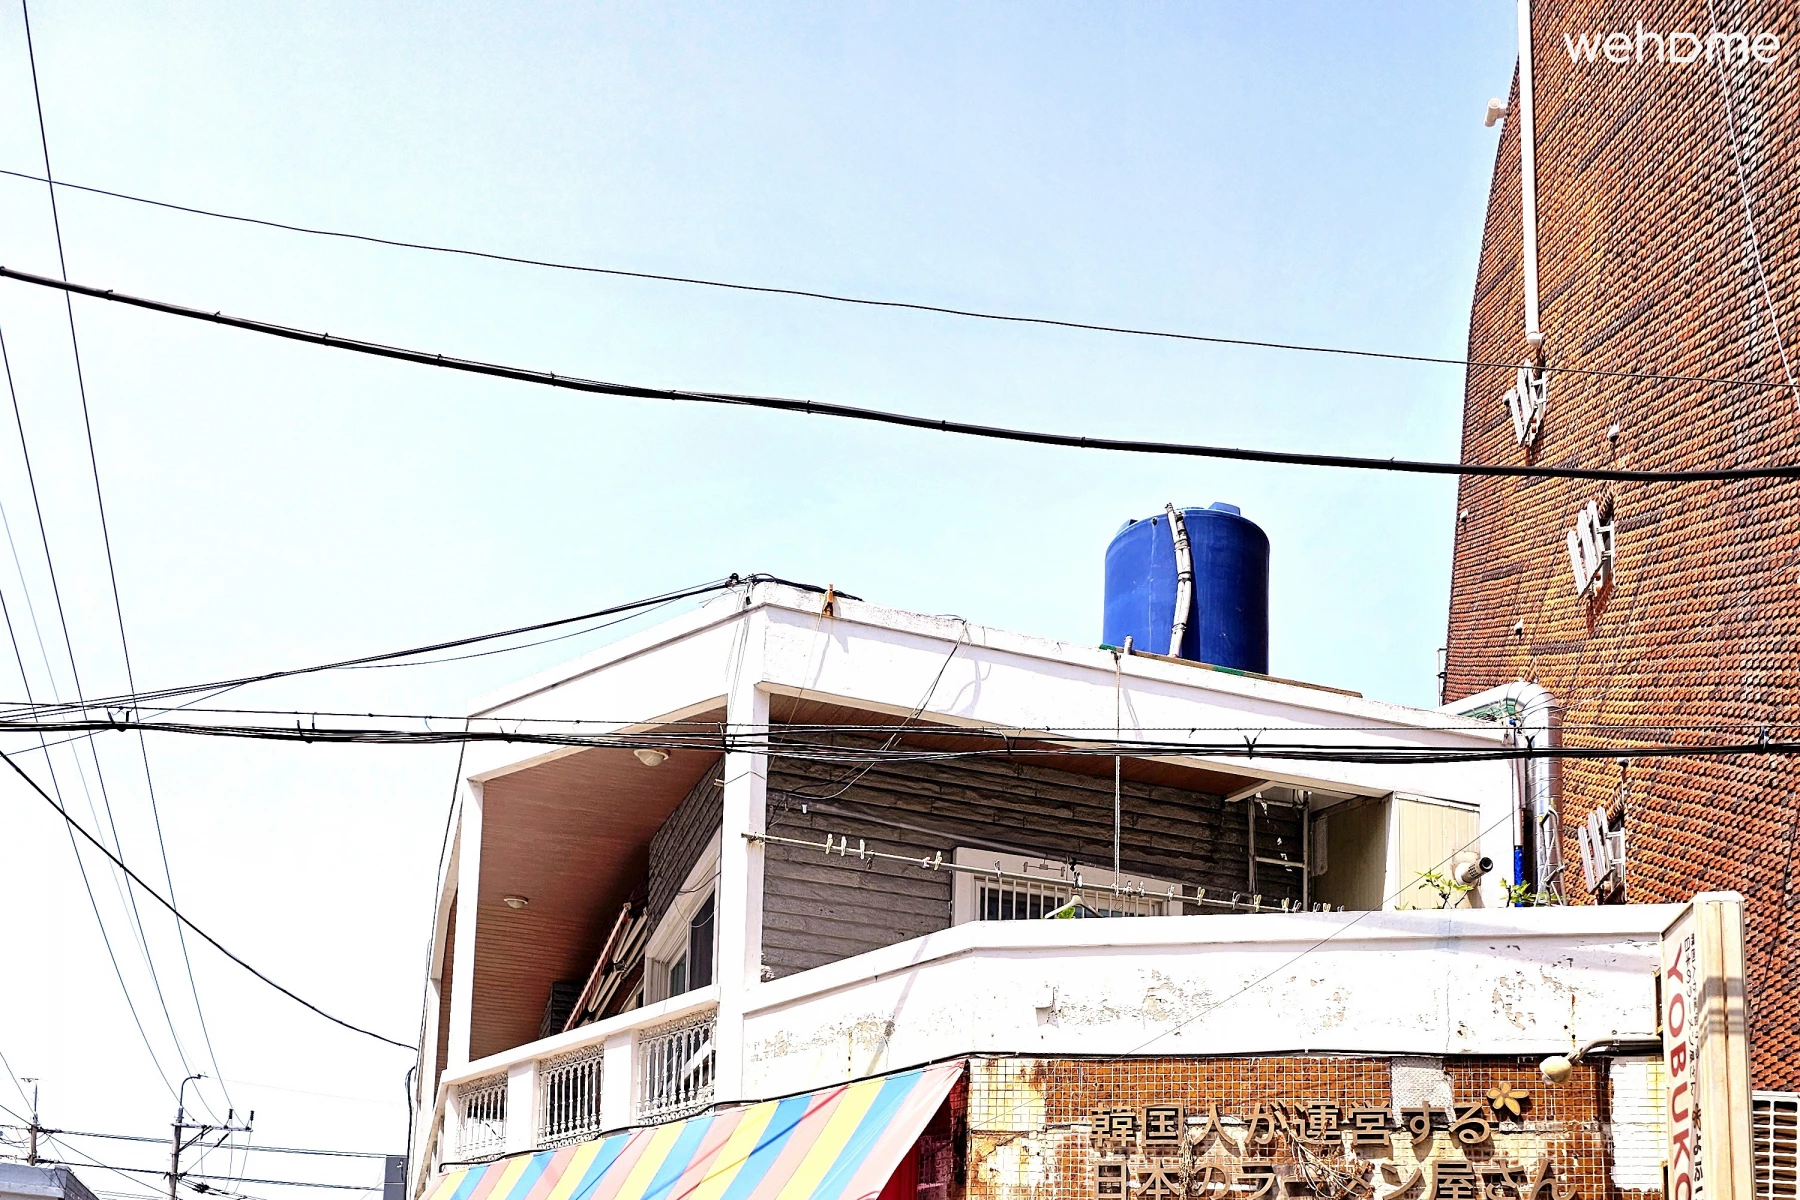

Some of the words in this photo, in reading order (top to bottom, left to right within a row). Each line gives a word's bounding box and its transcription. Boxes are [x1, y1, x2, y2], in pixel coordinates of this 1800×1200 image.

[1090, 1100, 1491, 1146] 韓国人が運営する
